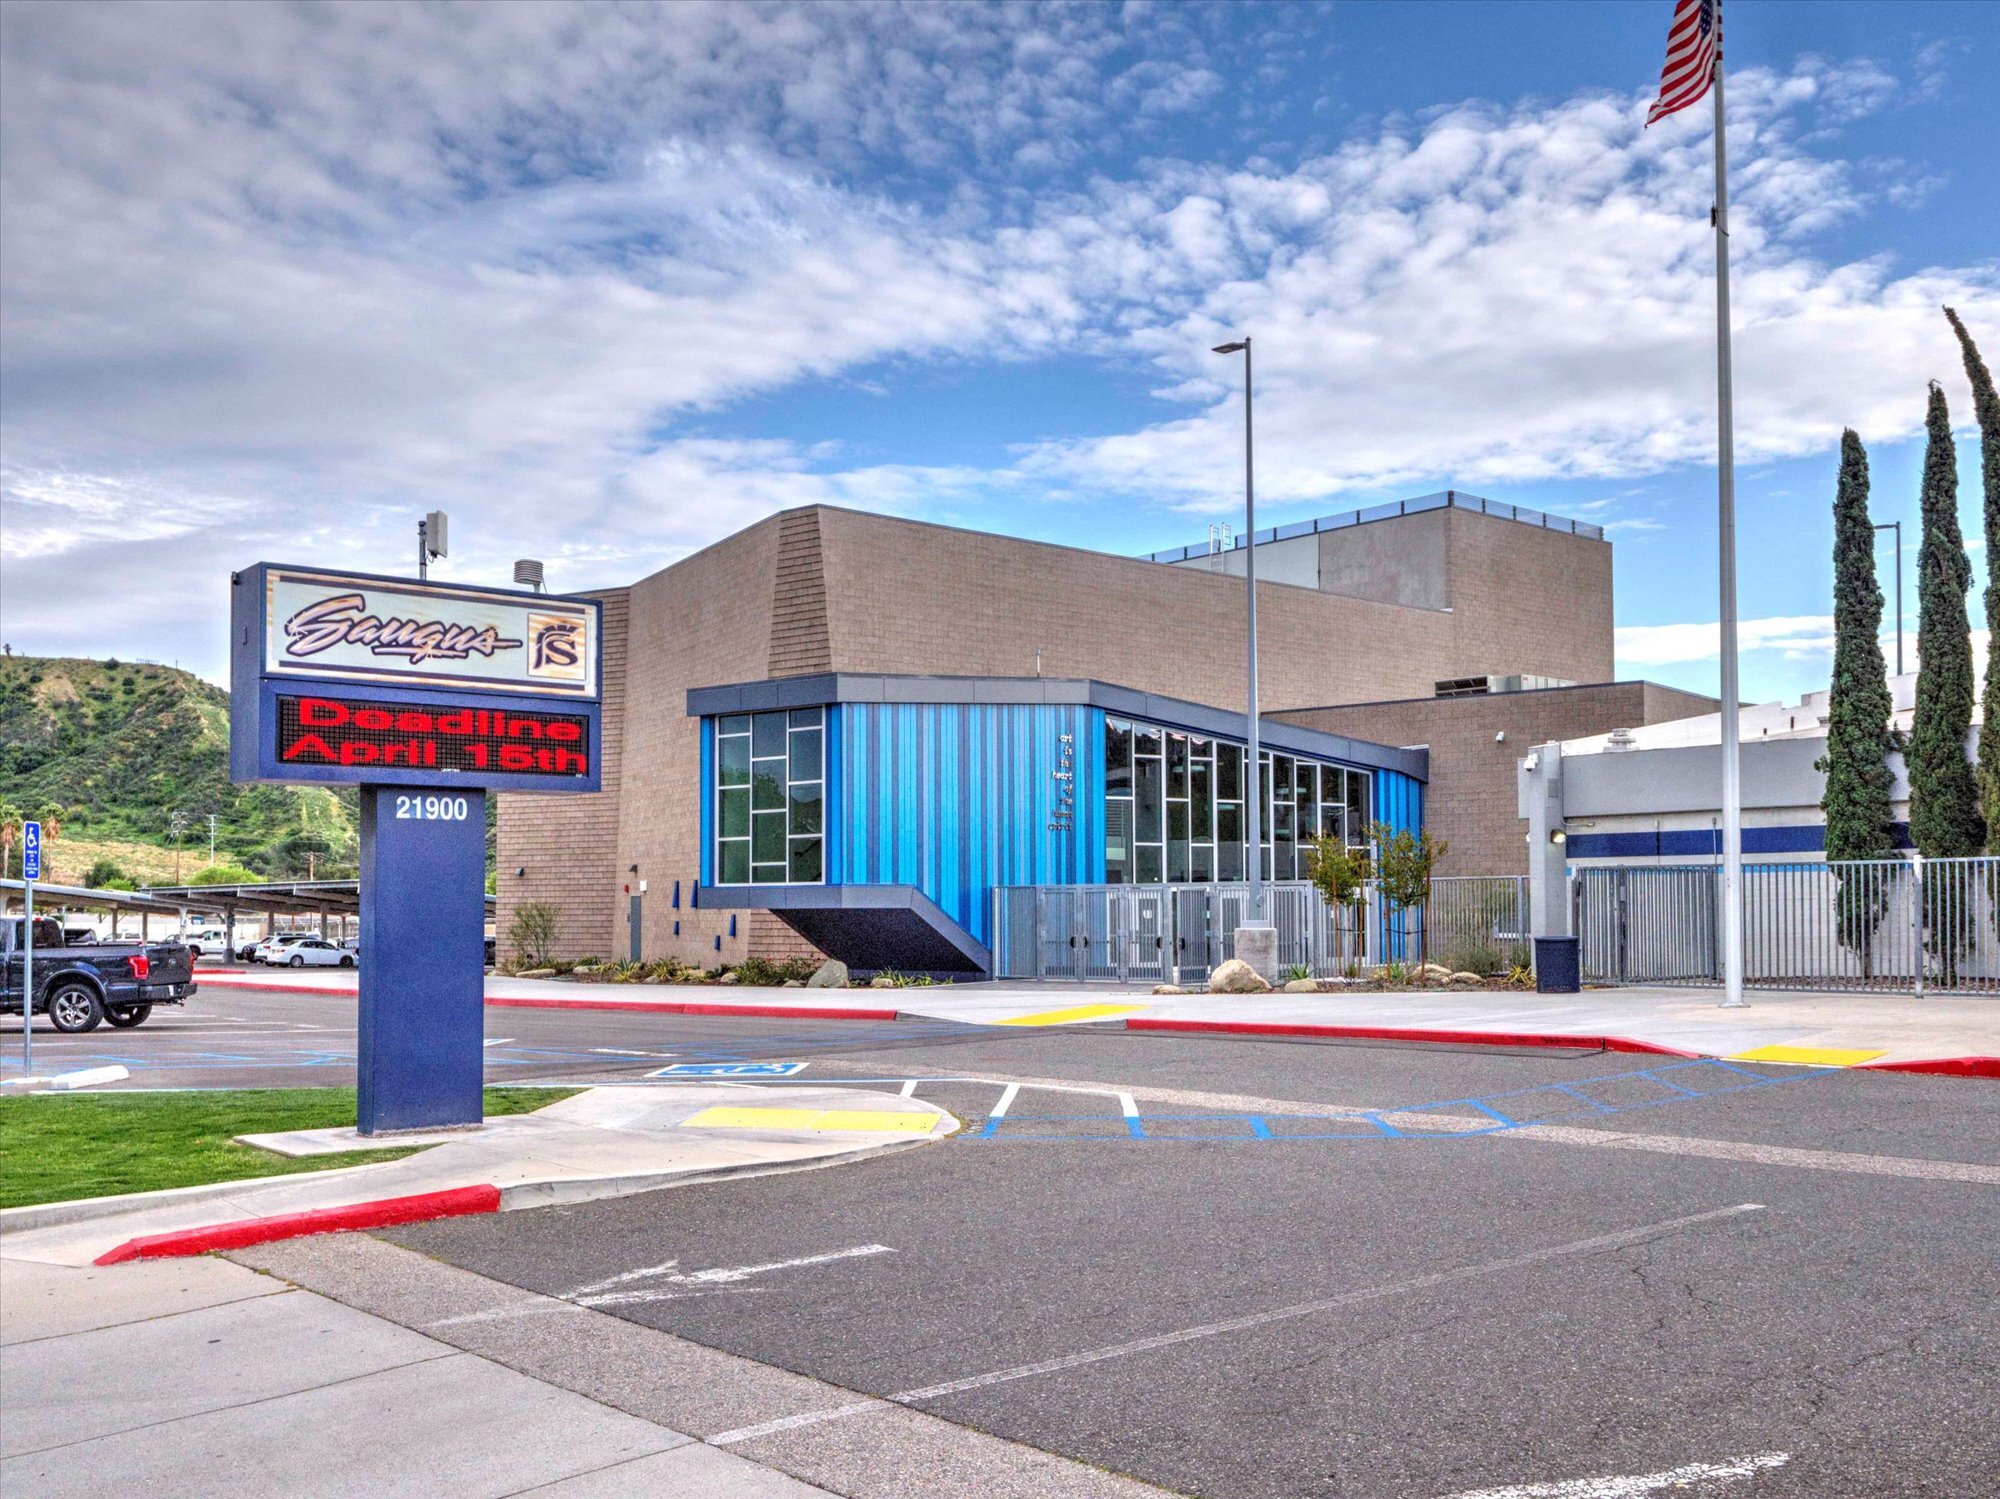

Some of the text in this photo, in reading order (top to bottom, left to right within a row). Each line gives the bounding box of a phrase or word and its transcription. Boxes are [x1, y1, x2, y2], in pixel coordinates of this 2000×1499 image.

[285, 593, 523, 664] Saugus
[282, 734, 588, 774] April 15th
[395, 796, 468, 820] 21900
